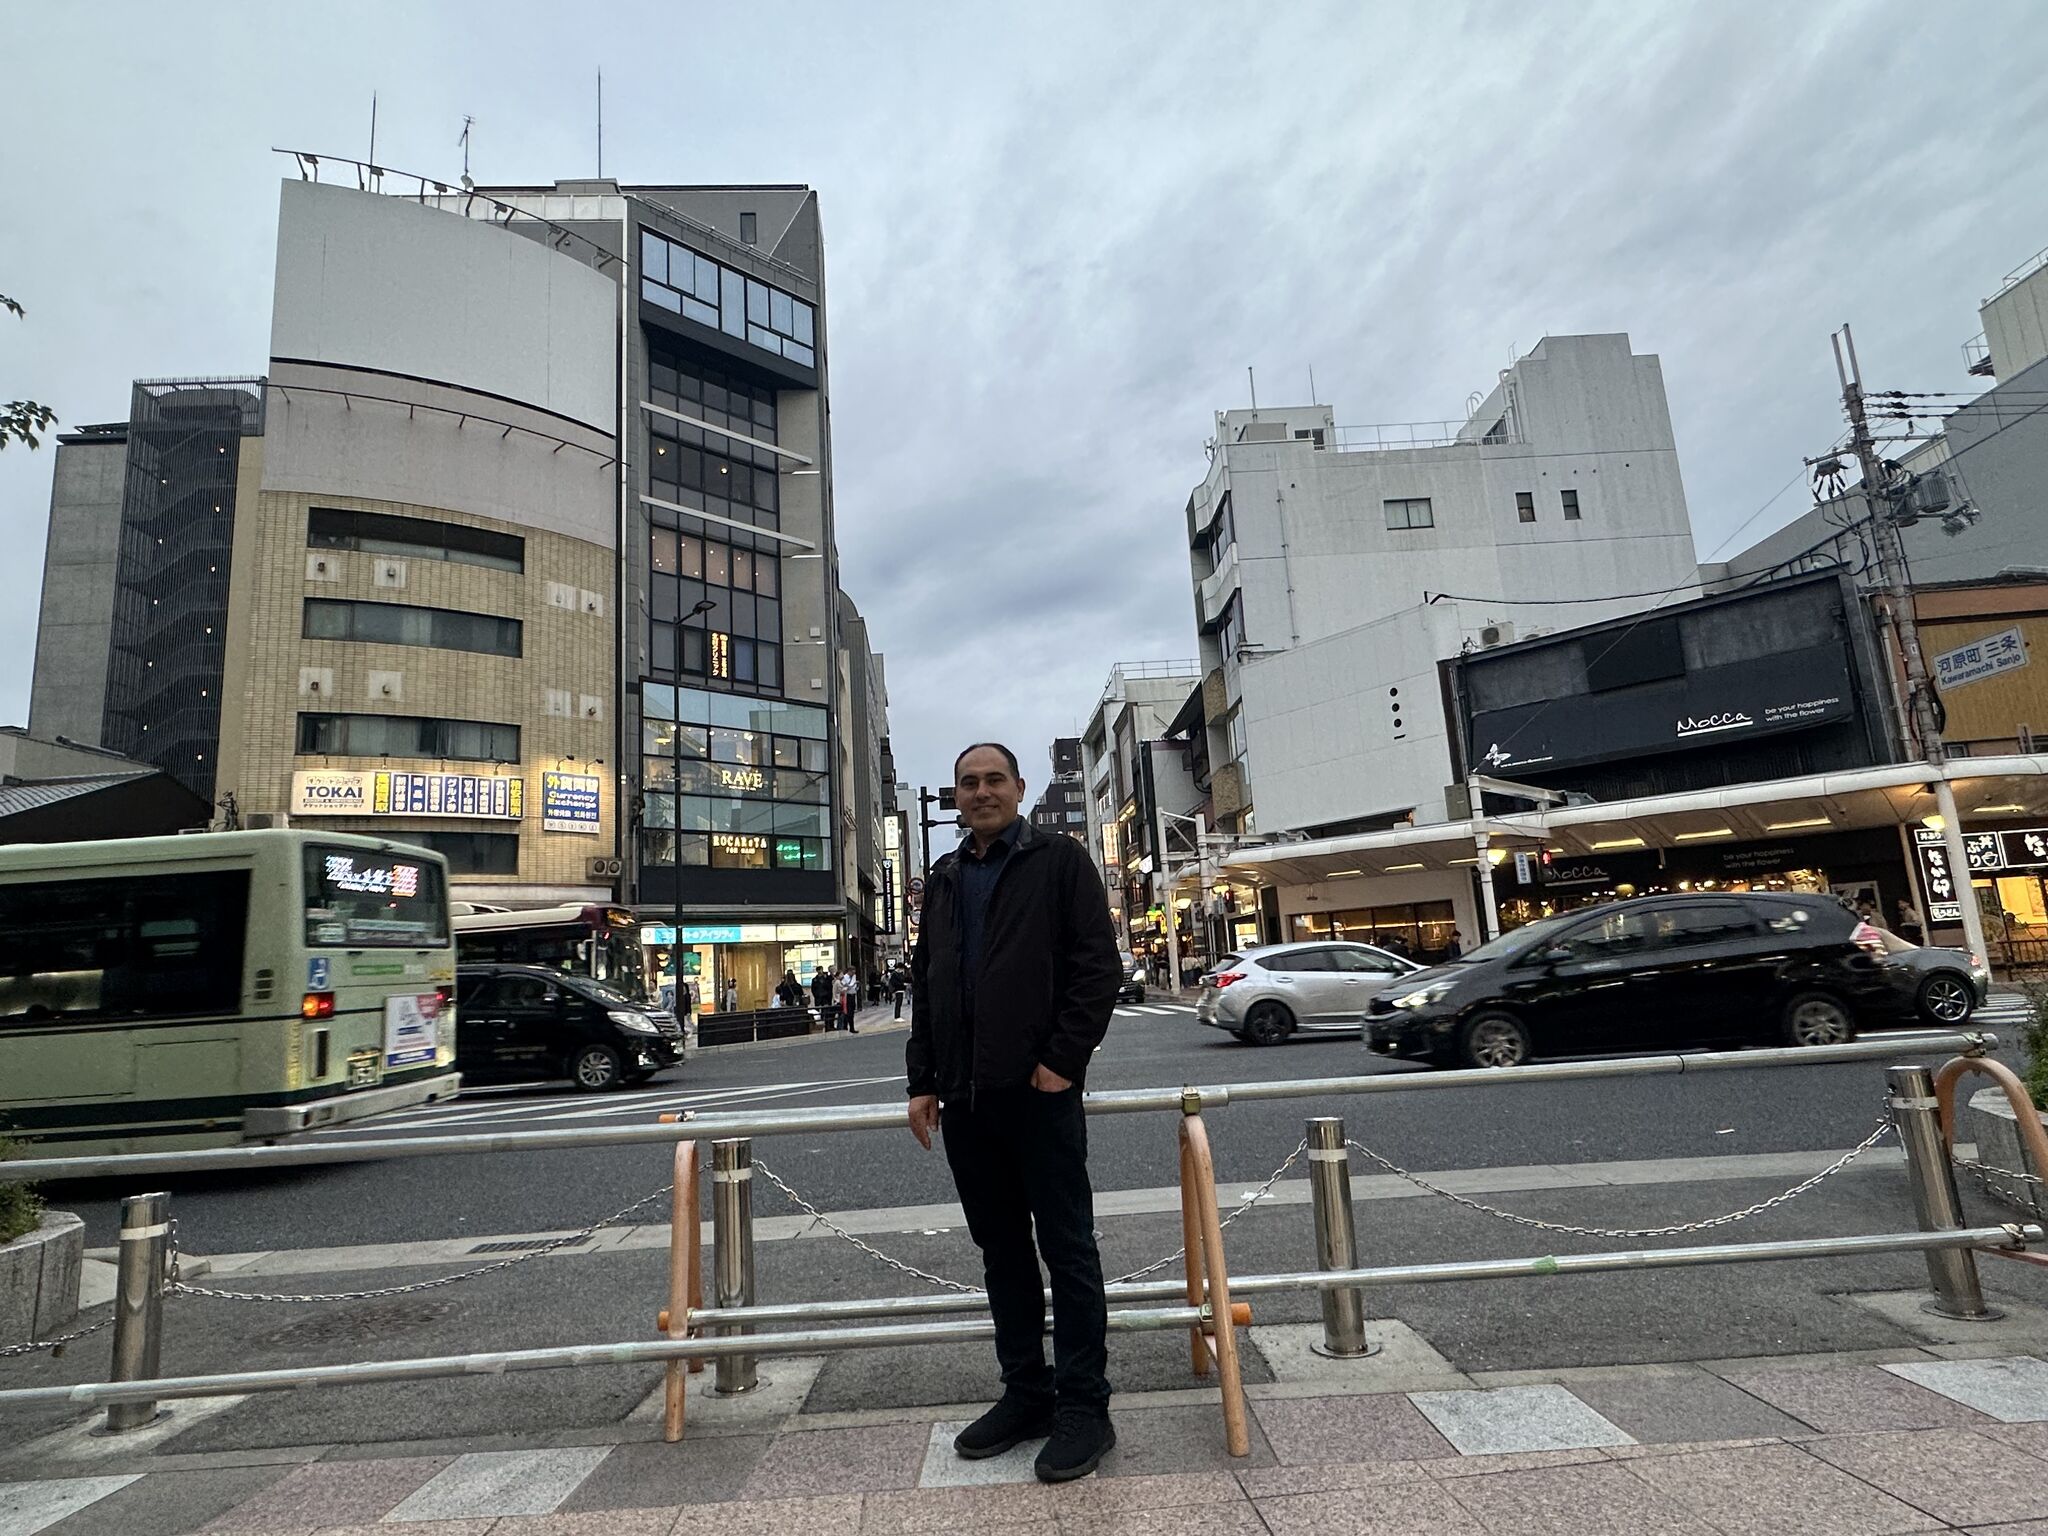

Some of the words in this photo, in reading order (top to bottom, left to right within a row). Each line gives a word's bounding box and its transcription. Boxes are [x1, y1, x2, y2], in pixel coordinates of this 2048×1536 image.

[1941, 661, 1994, 686] Kawaramachi
[1997, 653, 2021, 668] Sanjo
[1777, 705, 1796, 714] your
[1797, 697, 1839, 710] happiness
[1676, 712, 1752, 732] Mocca
[1765, 714, 1783, 722] with
[1784, 712, 1798, 720] the
[1799, 707, 1825, 717] flower
[305, 786, 363, 798] TOKAI
[549, 790, 597, 802] Currency
[547, 797, 597, 810] Exchange
[2024, 833, 2048, 859] な
[1928, 849, 1950, 898] なか卯
